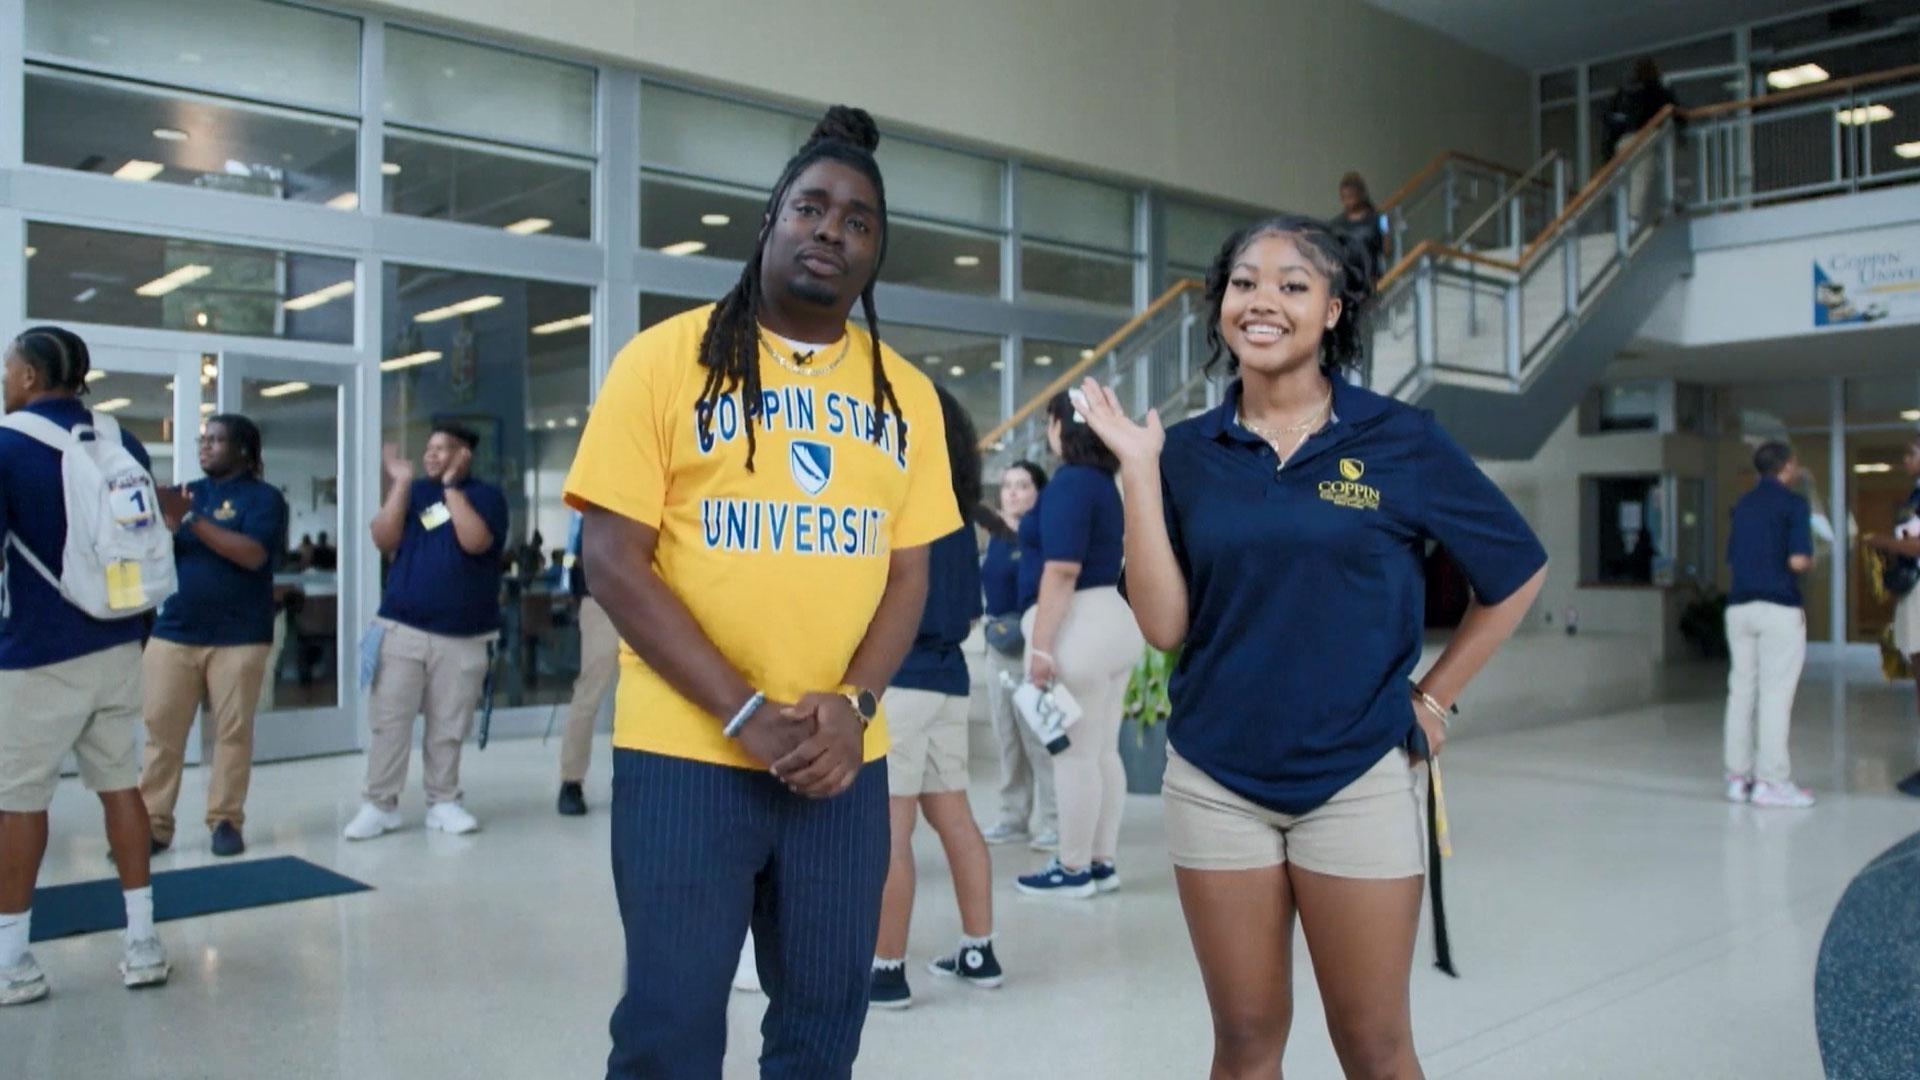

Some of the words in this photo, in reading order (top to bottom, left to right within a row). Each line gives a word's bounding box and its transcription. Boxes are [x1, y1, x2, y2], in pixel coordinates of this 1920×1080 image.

[130, 490, 146, 512] 1
[1318, 480, 1380, 501] COPPIN
[702, 499, 888, 556] UNIVERSIT
